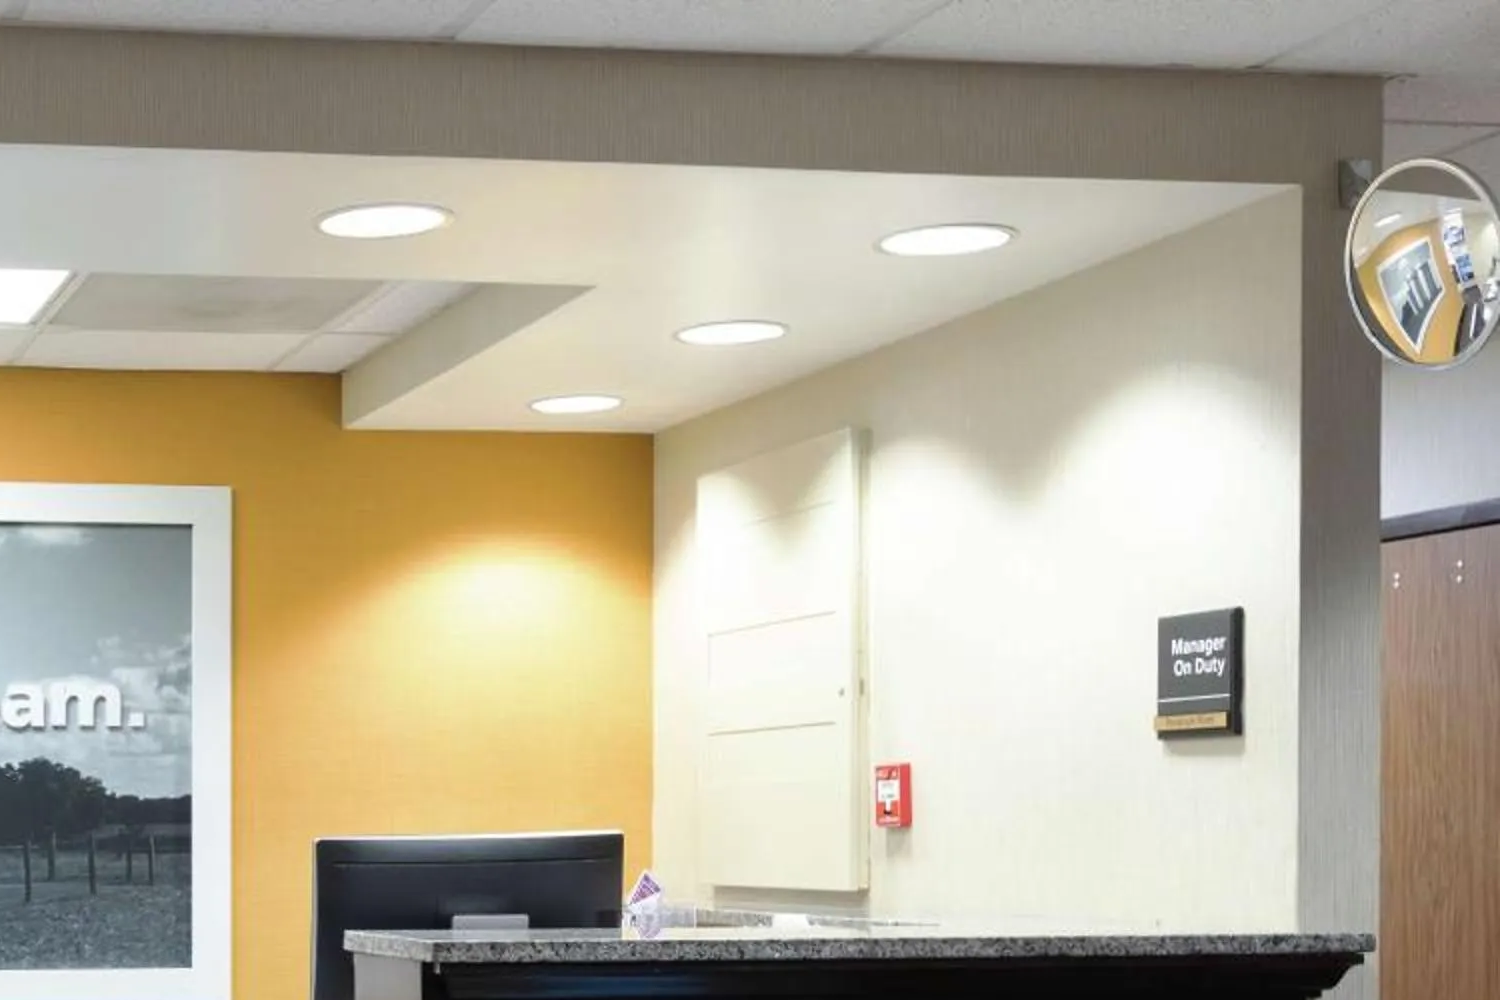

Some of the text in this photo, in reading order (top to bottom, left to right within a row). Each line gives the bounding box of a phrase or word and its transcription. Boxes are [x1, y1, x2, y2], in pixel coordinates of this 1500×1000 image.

[1171, 637, 1226, 656] Manager
[1174, 657, 1225, 677] On Duty
